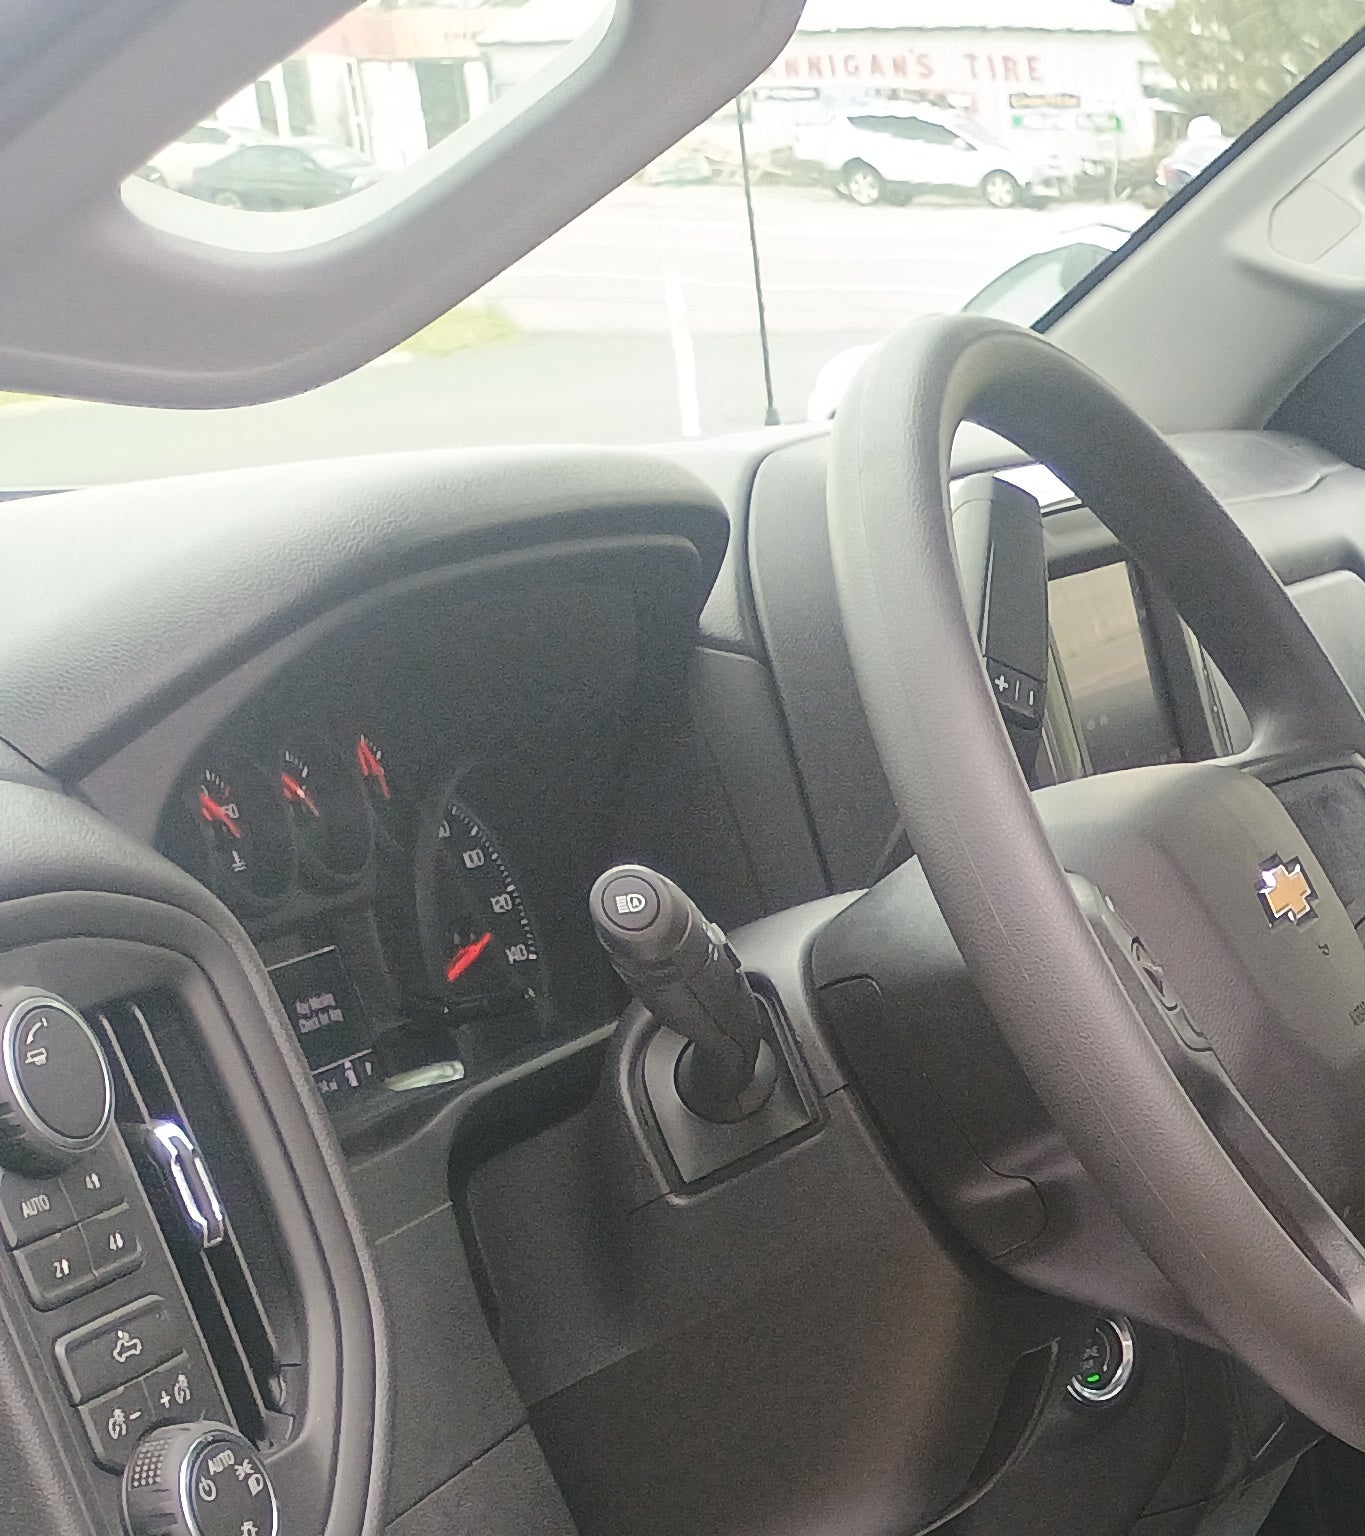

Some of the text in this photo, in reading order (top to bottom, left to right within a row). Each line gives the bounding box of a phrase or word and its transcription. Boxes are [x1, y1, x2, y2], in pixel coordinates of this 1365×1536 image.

[963, 53, 1041, 82] TIRE
[21, 1194, 50, 1218] AUTO
[208, 1450, 235, 1475] AUTO
